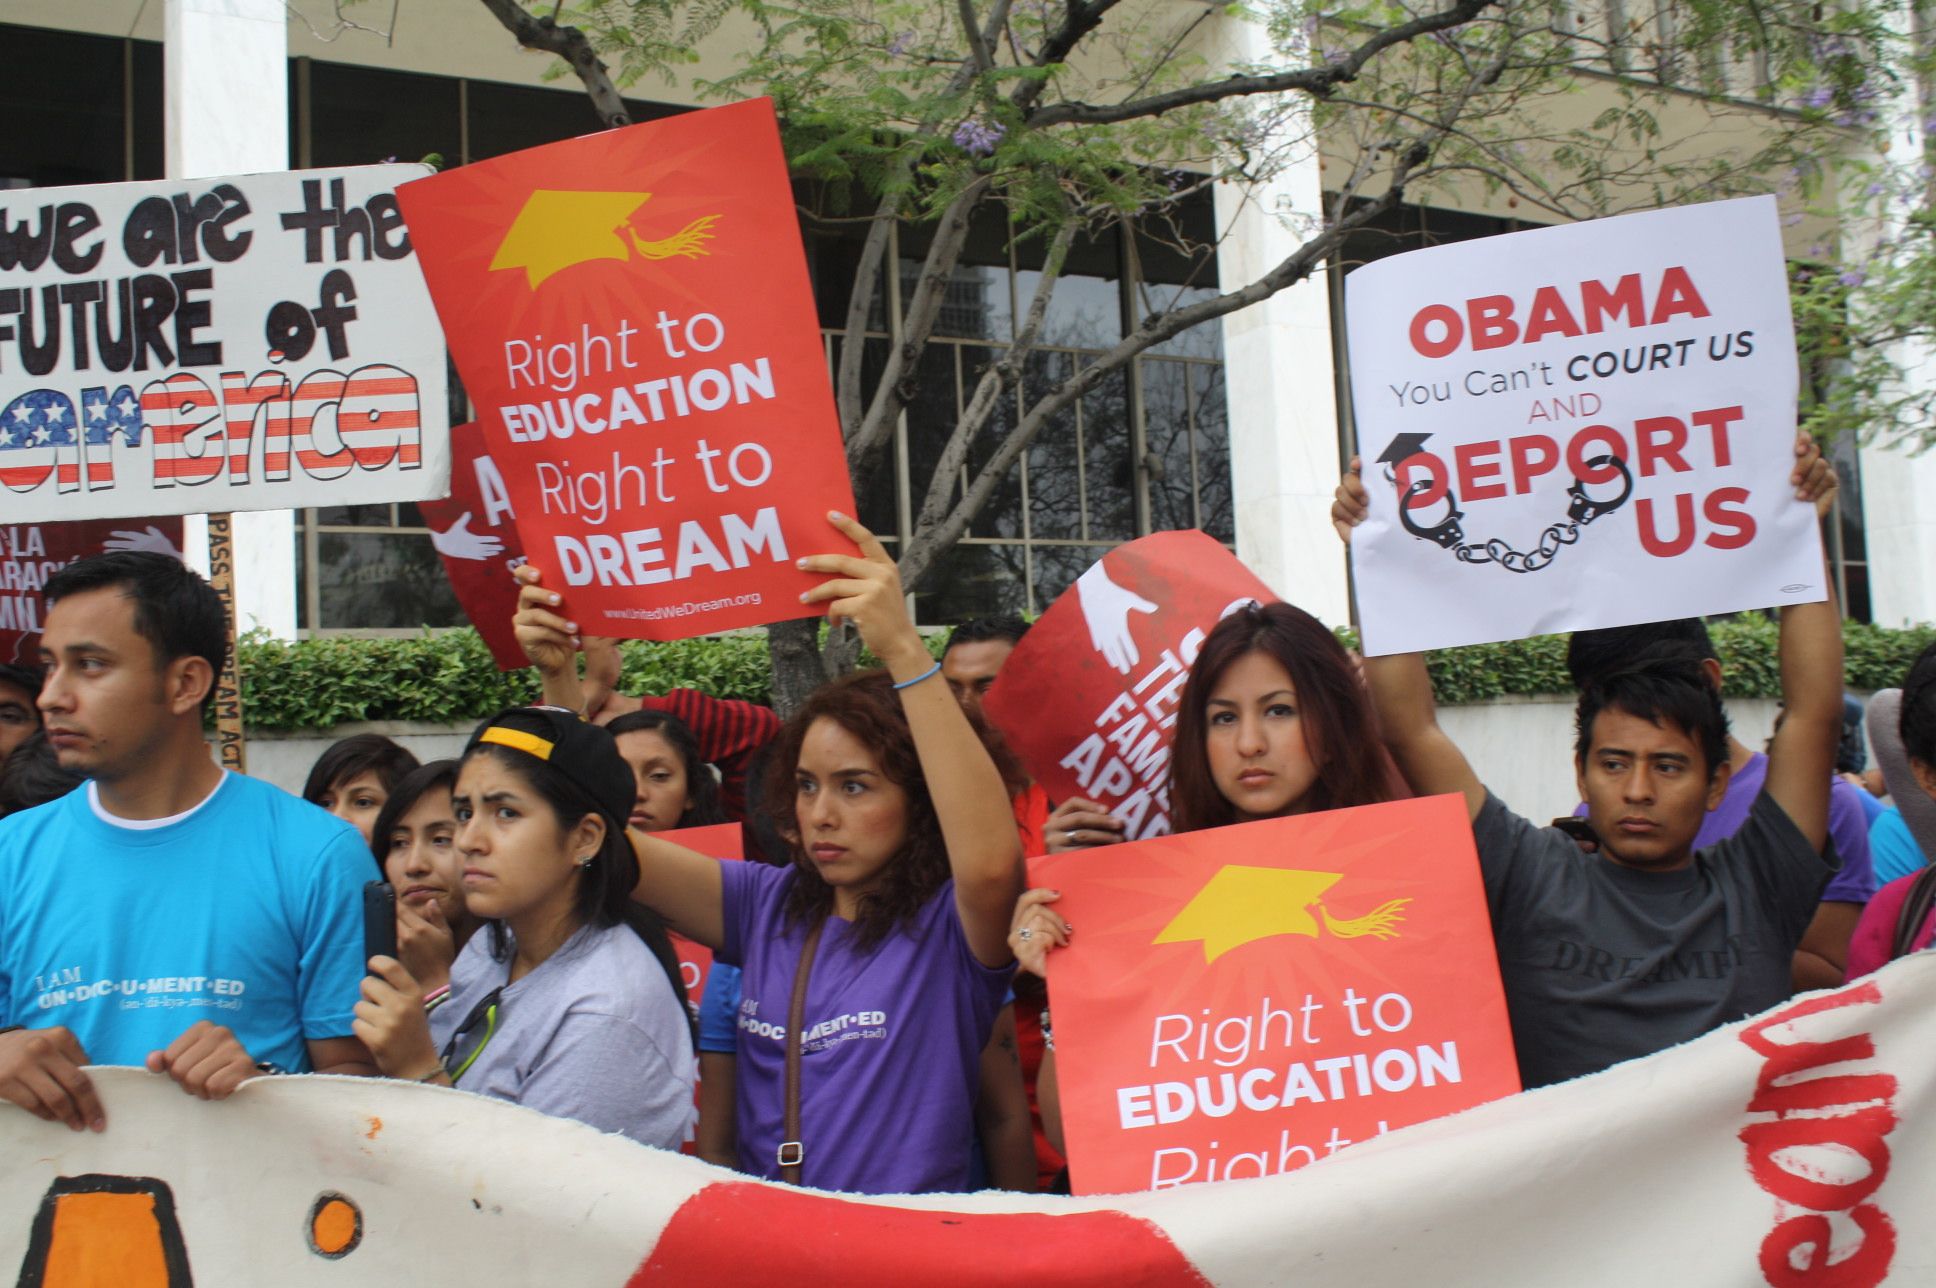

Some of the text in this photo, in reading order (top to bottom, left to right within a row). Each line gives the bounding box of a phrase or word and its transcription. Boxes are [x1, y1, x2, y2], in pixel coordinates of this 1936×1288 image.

[0, 178, 414, 275] we are the
[0, 268, 358, 376] FUTURE of
[504, 311, 725, 392] Right to
[1409, 266, 1711, 359] OBAMA
[500, 357, 776, 443] EDUCATION
[1389, 330, 1755, 408] You Can't COURT US
[1527, 392, 1602, 425] AND
[0, 350, 421, 495] america
[1394, 405, 1744, 510] DEPORT
[535, 439, 773, 527] Right to
[1635, 487, 1758, 558] US
[554, 506, 789, 587] DREAM
[208, 519, 230, 577] PASS
[221, 730, 242, 769] ACT
[48, 966, 82, 990] AM
[1149, 988, 1413, 1067] Right to
[1117, 1041, 1462, 1130] EDUCATION
